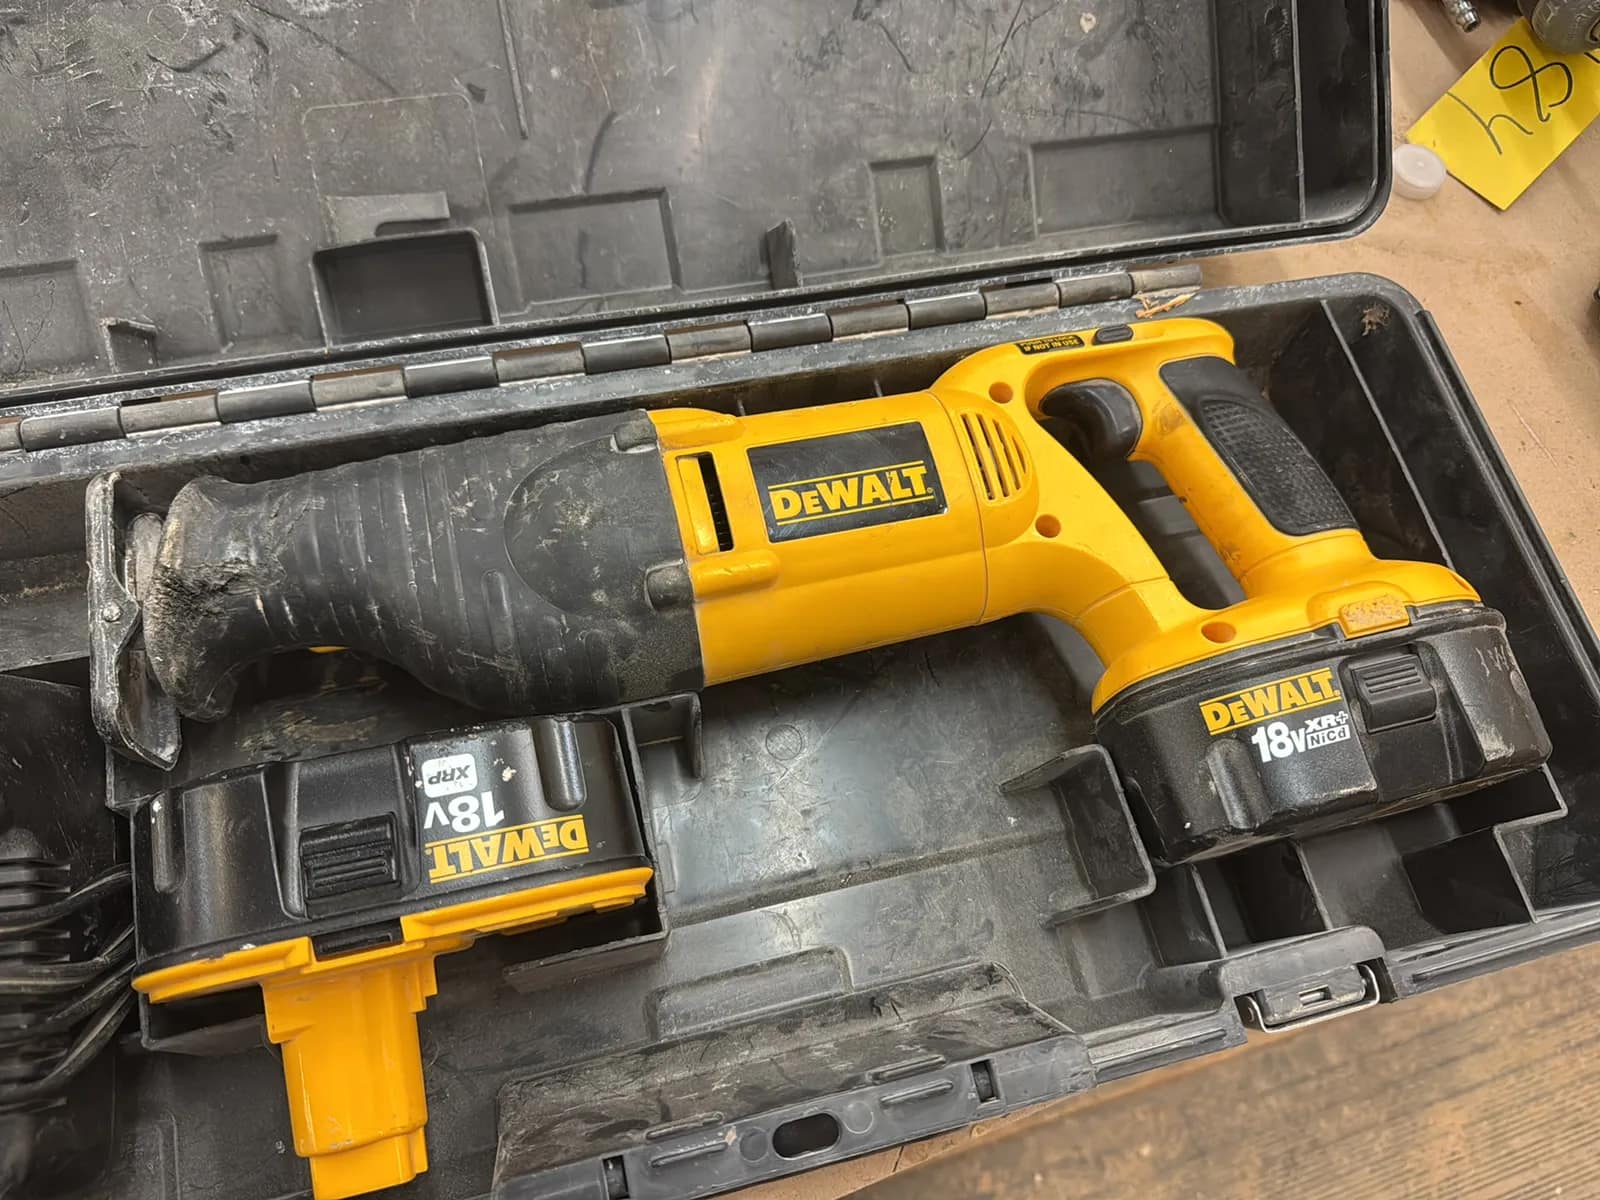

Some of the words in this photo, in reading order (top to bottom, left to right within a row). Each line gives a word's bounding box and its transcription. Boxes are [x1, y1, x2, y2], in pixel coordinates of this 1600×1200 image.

[1446, 45, 1600, 155] 84
[1032, 342, 1050, 351] NOT
[1062, 338, 1080, 347] USE
[768, 465, 928, 520] DEWALT
[1199, 671, 1336, 732] DEWALT
[1304, 711, 1349, 733] XR+
[1309, 727, 1348, 748] NiCd
[427, 764, 471, 785] XRP
[427, 819, 590, 879] DEWALT
